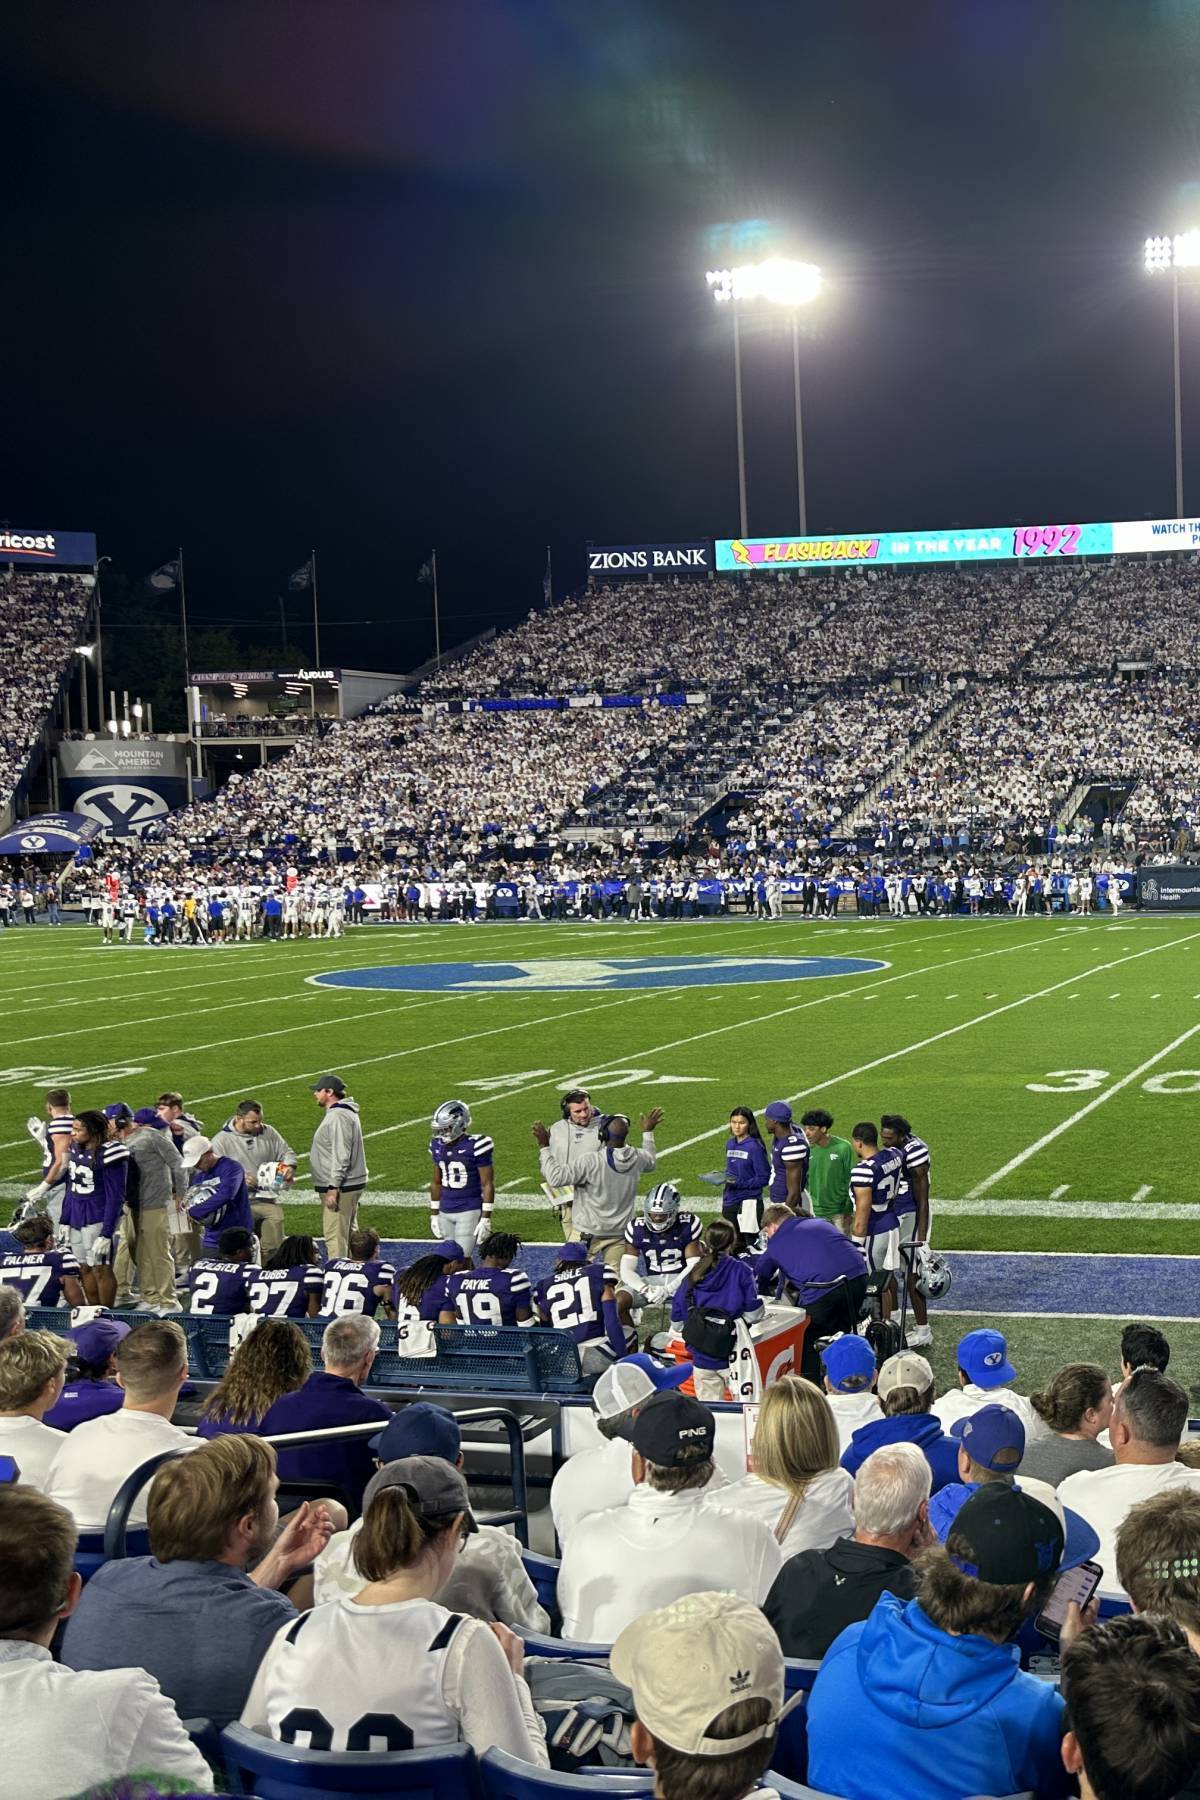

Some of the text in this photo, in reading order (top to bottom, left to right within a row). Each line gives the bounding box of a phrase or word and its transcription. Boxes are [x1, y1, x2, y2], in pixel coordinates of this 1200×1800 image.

[1152, 523, 1186, 535] WATCH
[763, 524, 1082, 563] FLASHBACK IN THE YEAR 1992
[589, 548, 707, 569] ZIONS BANK
[114, 750, 164, 759] MOUNTAIN
[118, 758, 161, 766] AMERICA
[438, 1160, 468, 1189] 10
[3, 1253, 45, 1266] PALMER
[645, 1248, 683, 1273] 12
[259, 1268, 290, 1281] COBBS
[460, 1278, 492, 1291] PAYNE
[554, 1266, 583, 1283] SIGLE
[190, 1272, 219, 1315] 2
[250, 1281, 299, 1318] 27
[318, 1271, 369, 1318] 36
[546, 1276, 598, 1330] 21
[455, 1292, 503, 1326] 19
[679, 1426, 708, 1440] PING
